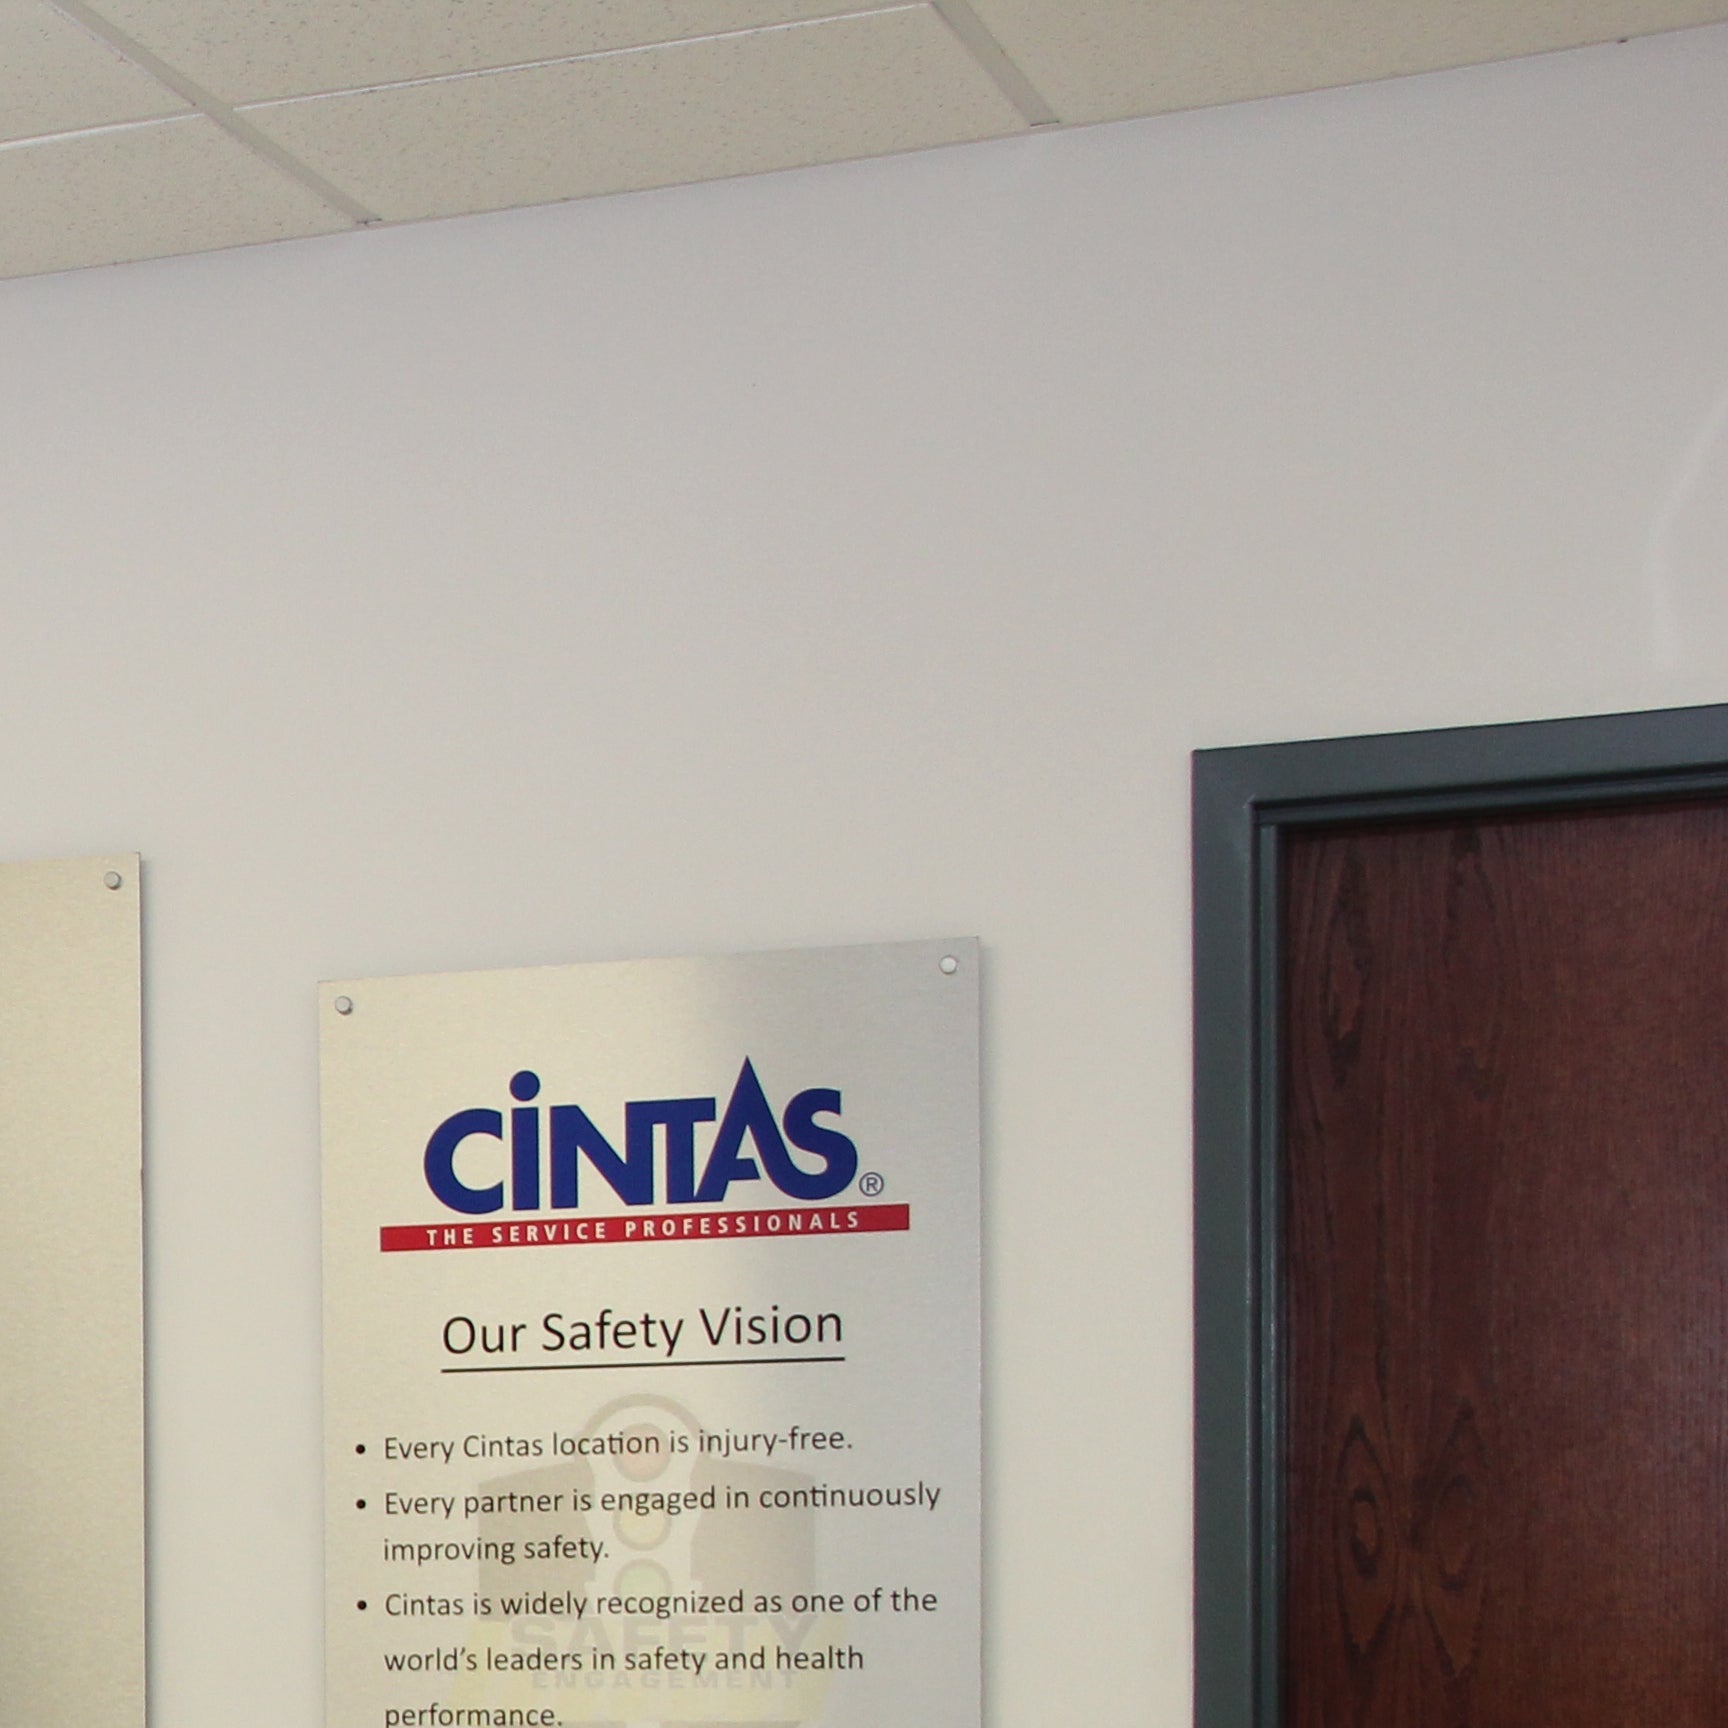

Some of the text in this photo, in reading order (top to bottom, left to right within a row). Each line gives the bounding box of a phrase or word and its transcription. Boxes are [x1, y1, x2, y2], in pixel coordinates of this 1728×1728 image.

[427, 1210, 860, 1245] THE SERVICE PROFESSIONALS
[441, 1305, 844, 1357] Our Safety Vision
[383, 1424, 854, 1463] Every Cintas location is injury-free.
[383, 1481, 940, 1519] Every partner is engaged in continuously
[383, 1533, 609, 1565] improving safety.
[384, 1587, 938, 1621] Cintas is widely recognized as one of the
[511, 1614, 820, 1653] SAFETY
[486, 1646, 583, 1672] leaders
[591, 1647, 616, 1671] in
[624, 1645, 706, 1677] safety
[714, 1645, 765, 1671] and
[773, 1645, 863, 1671] health
[533, 1670, 798, 1689] ENGAGEMENT
